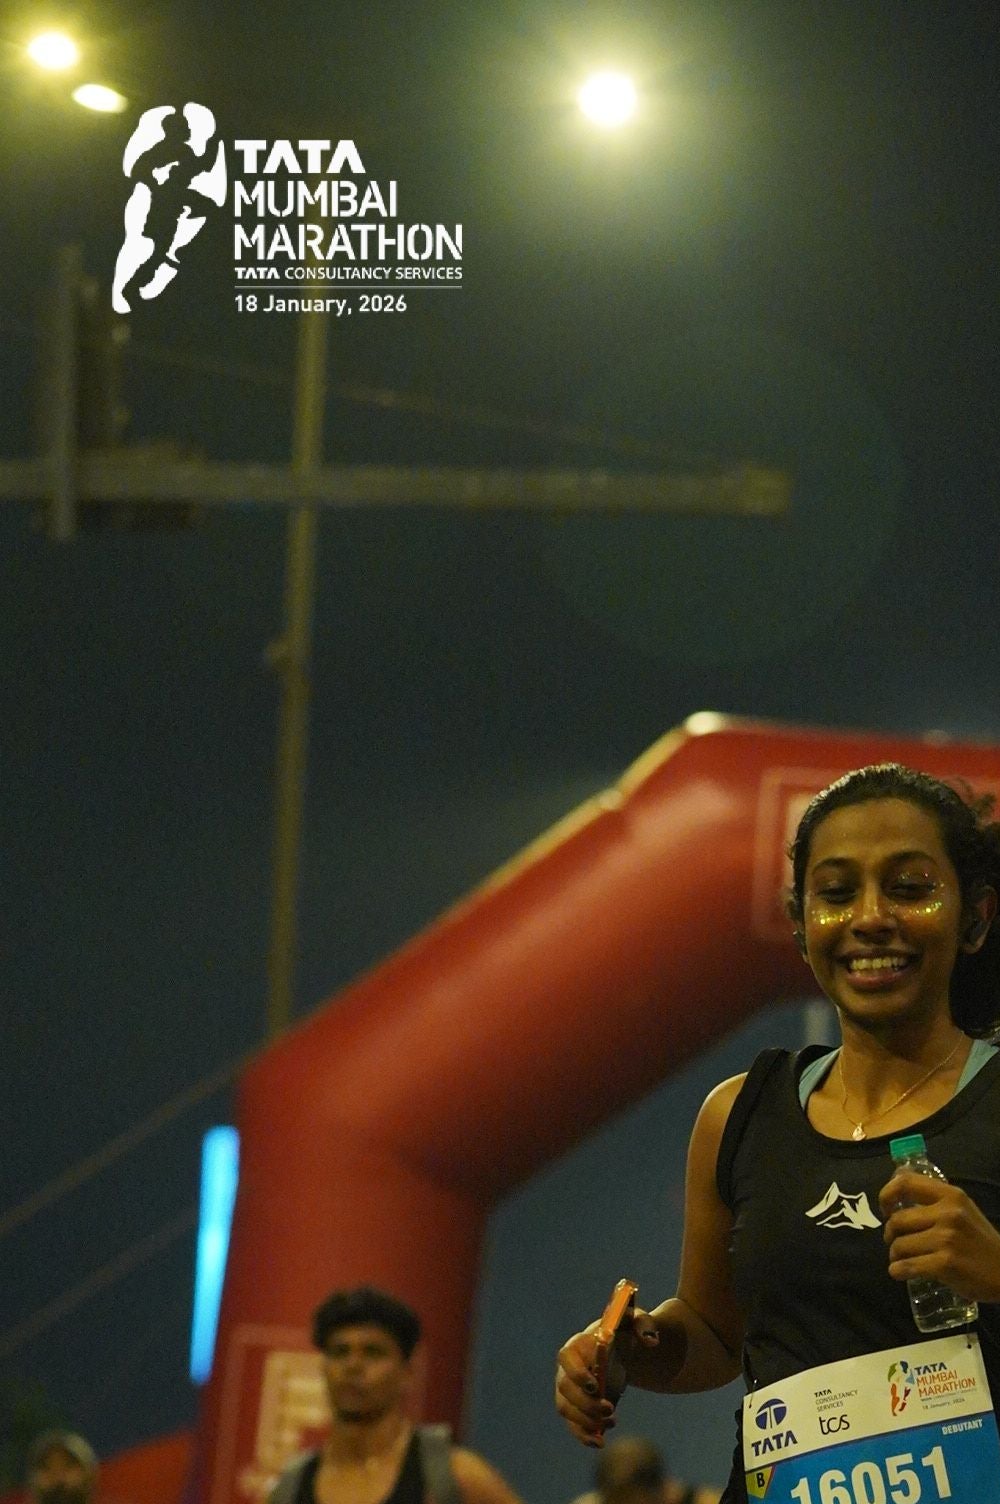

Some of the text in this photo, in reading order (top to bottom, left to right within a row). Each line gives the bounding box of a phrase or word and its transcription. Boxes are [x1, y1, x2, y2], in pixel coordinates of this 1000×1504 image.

[914, 1362, 947, 1376] TATA
[916, 1370, 958, 1387] MUMBAI
[813, 1389, 832, 1398] TATA
[919, 1378, 977, 1397] MARATHON
[816, 1401, 844, 1412] SERVICES
[818, 1414, 851, 1435] tcs
[942, 1419, 983, 1435] DEBUTANT
[751, 1430, 798, 1457] TATA
[756, 1473, 766, 1488] B
